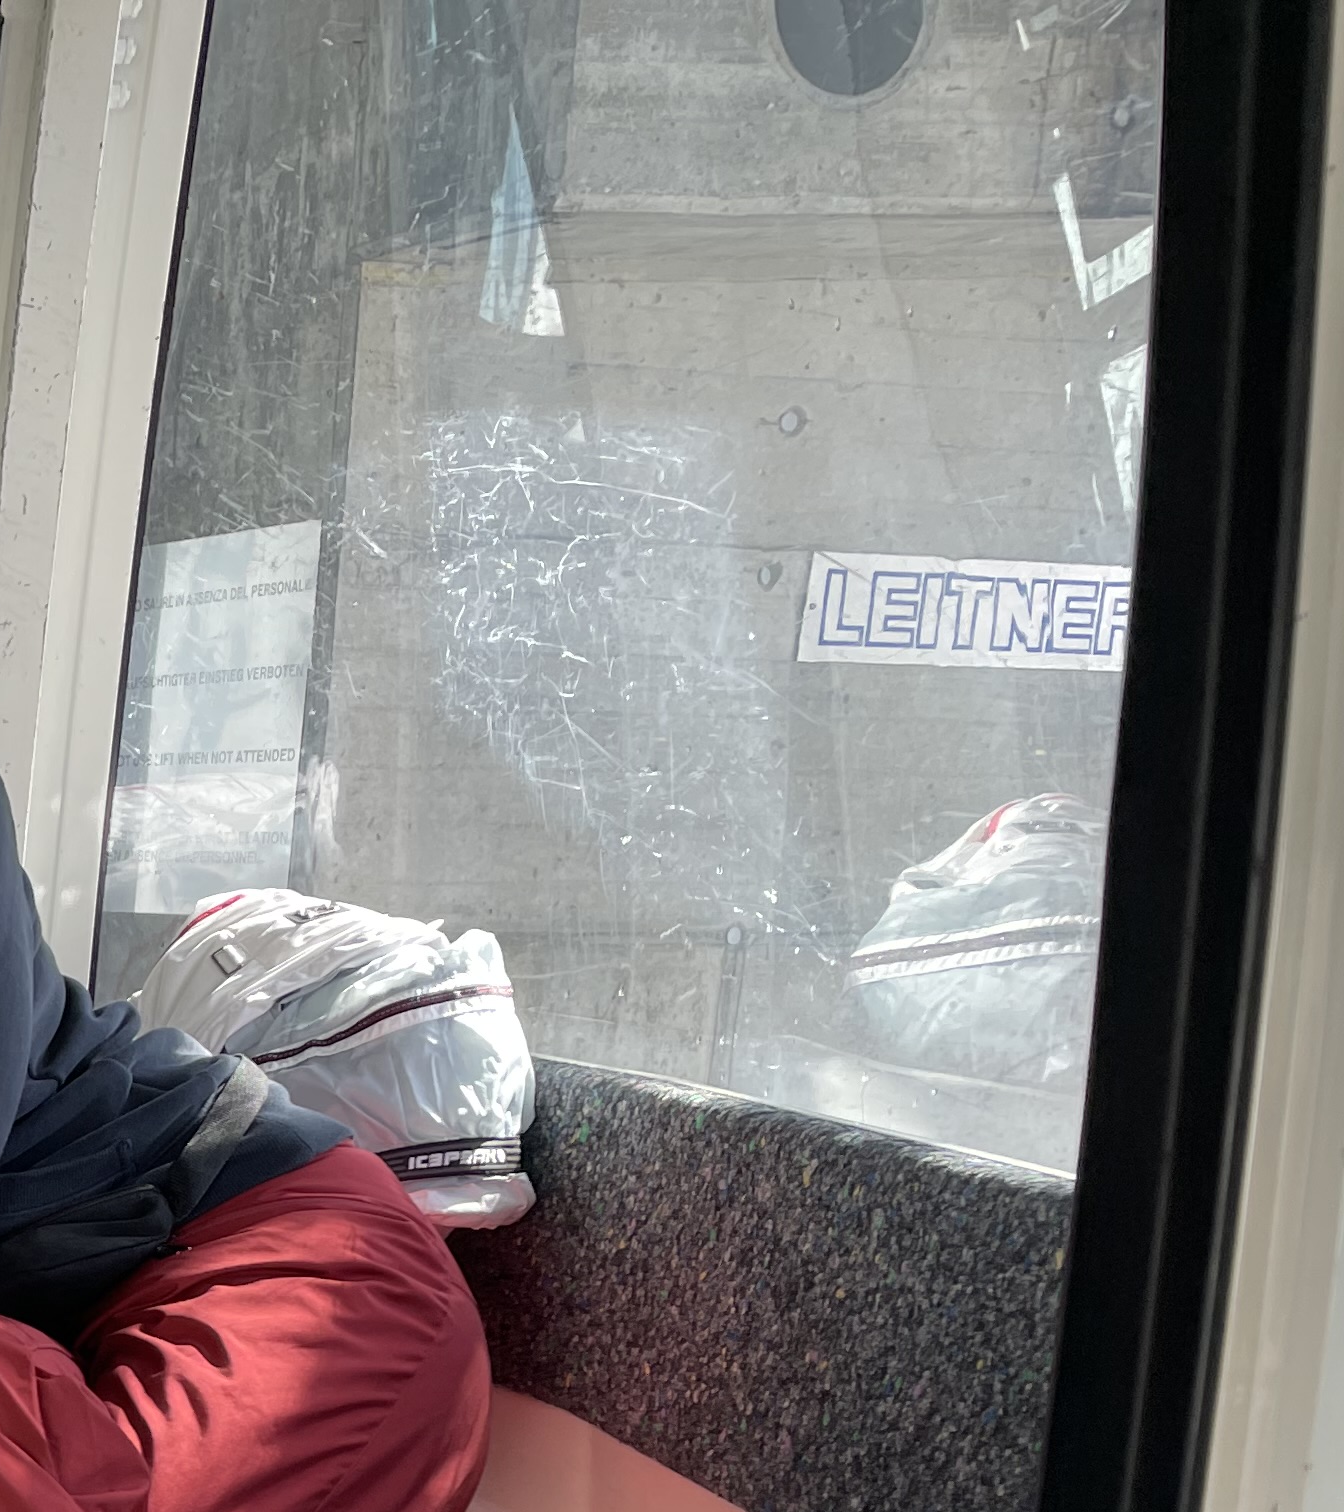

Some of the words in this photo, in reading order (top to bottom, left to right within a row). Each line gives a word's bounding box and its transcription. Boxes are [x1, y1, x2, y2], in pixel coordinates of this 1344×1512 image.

[818, 568, 1131, 656] LEITNER
[246, 663, 304, 681] VERBOTEN
[178, 751, 209, 766] WHEN
[211, 750, 234, 765] NOT
[235, 747, 296, 764] ATTENDED
